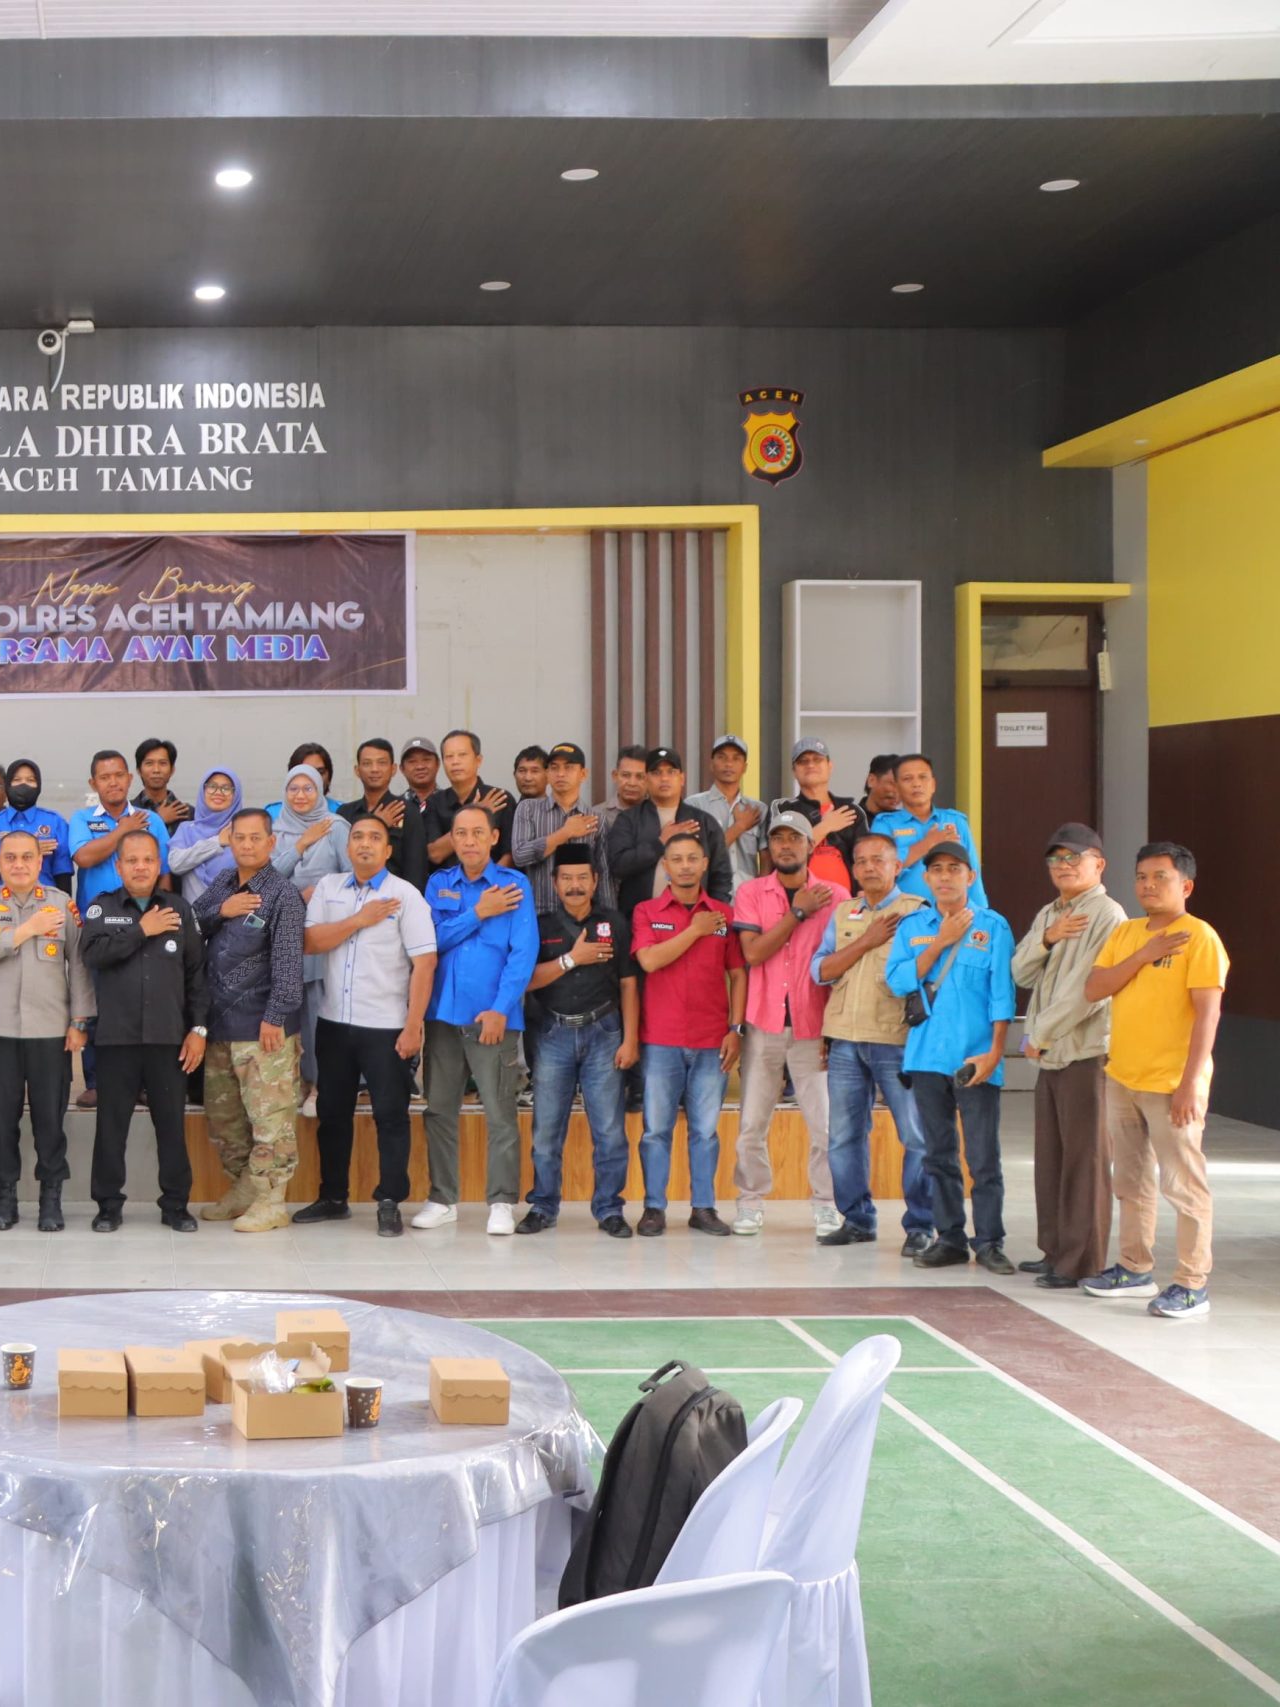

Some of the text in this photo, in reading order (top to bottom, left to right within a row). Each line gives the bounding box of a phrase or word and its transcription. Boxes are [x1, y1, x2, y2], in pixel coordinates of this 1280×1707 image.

[60, 383, 184, 411] REPUBLIK
[195, 382, 326, 410] INDONESIA
[744, 390, 800, 402] ACEH
[55, 424, 187, 458] DHIRA
[199, 422, 328, 456] BRATA
[96, 465, 254, 492] TAMIANG
[30, 568, 119, 607] Ngopi
[103, 602, 194, 632] ACEH
[201, 600, 365, 631] TAMIANG
[122, 635, 218, 663] AWAK
[226, 634, 330, 662] MEDIA
